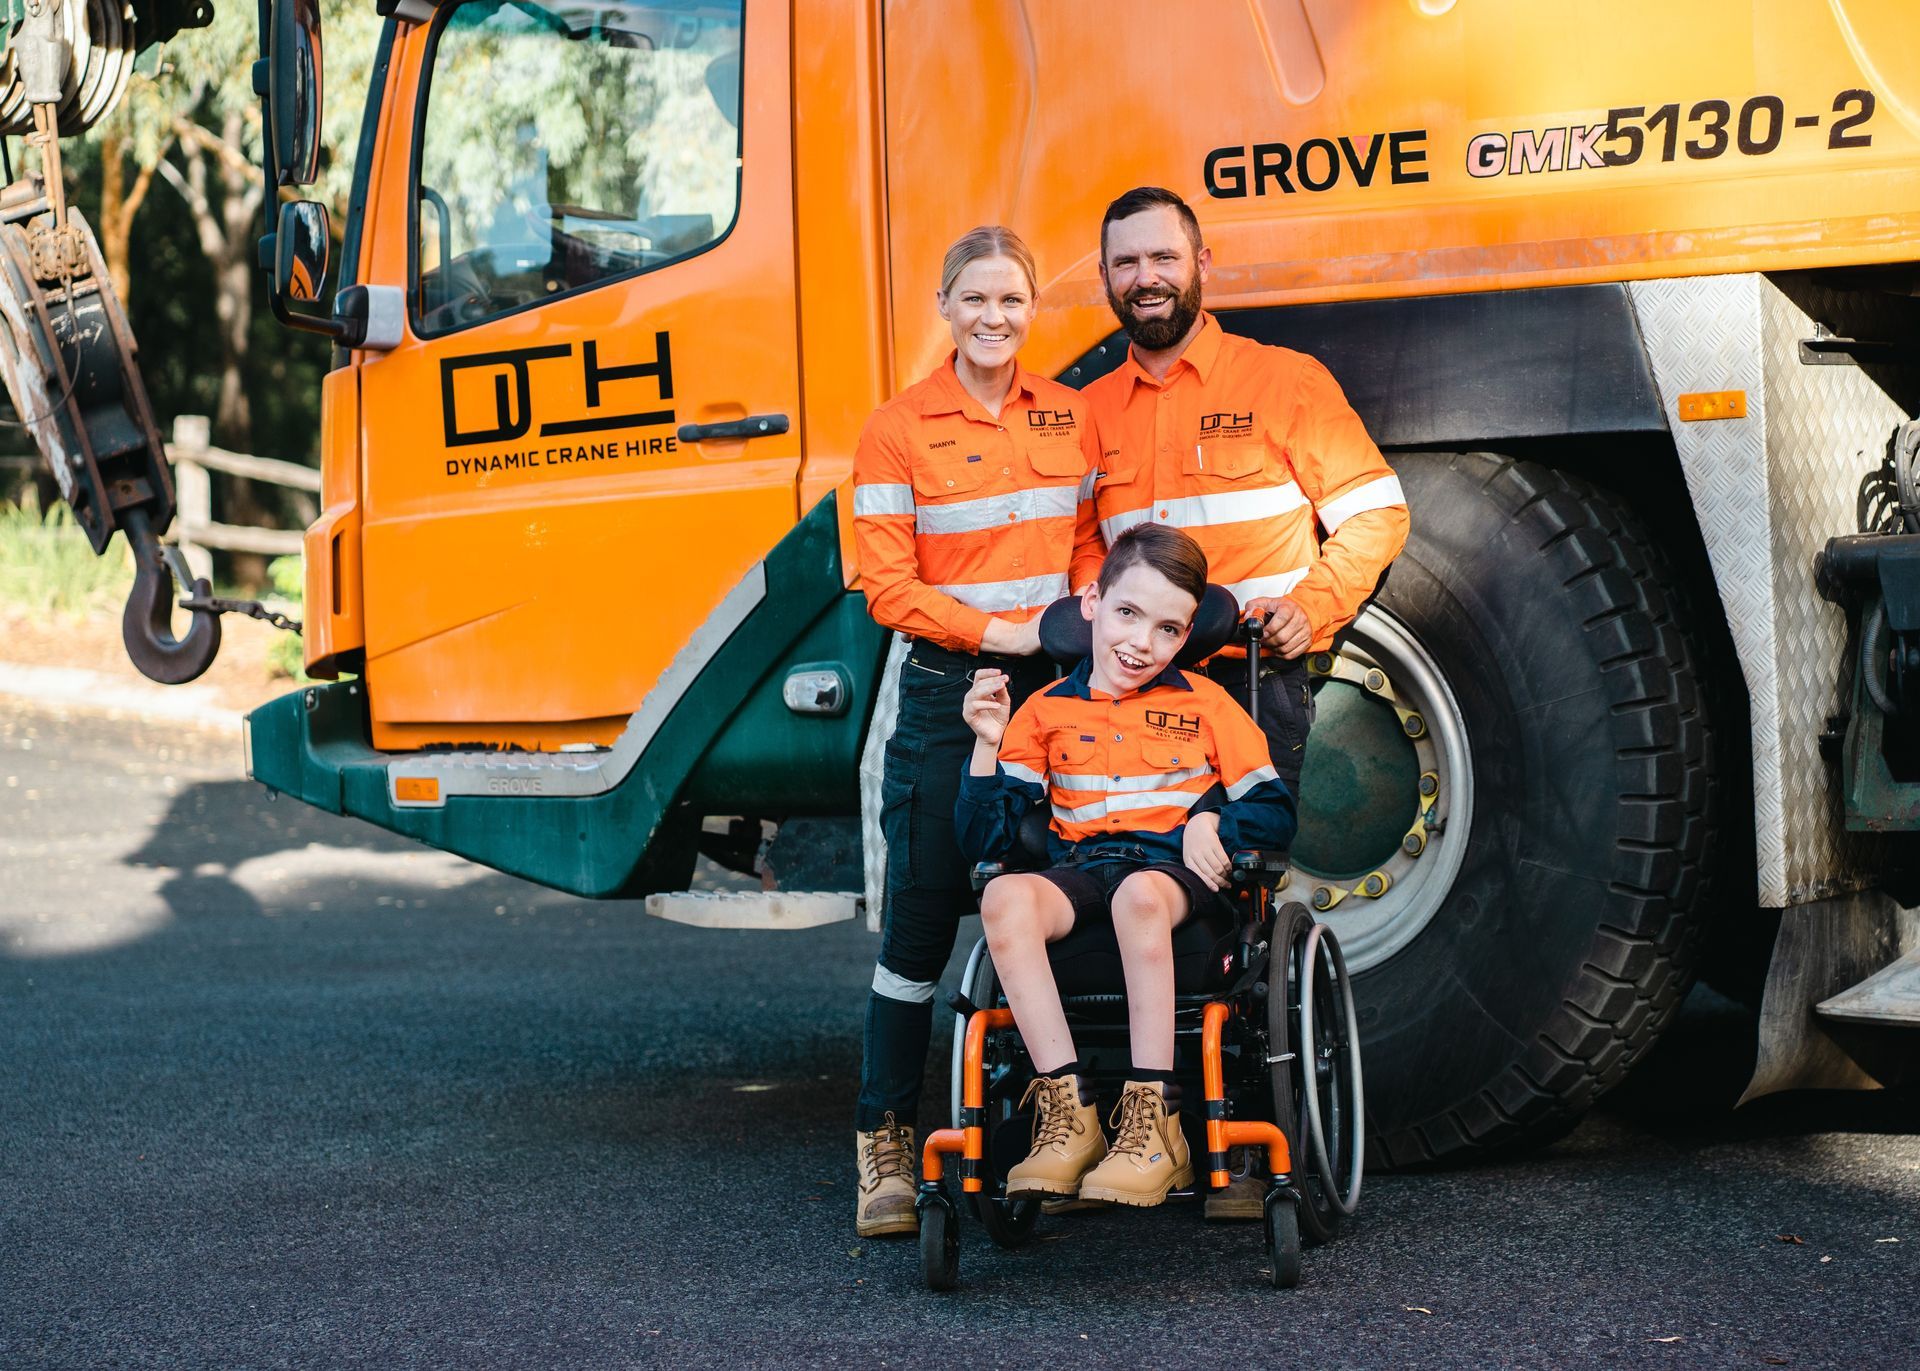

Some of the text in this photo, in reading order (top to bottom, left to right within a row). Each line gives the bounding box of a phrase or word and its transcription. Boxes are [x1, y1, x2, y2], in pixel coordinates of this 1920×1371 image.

[1204, 130, 1429, 199] GROVE
[446, 436, 677, 475] DYNAMIC CRANE HIRE
[928, 439, 956, 449] SHANYN
[487, 776, 542, 793] GROVE
